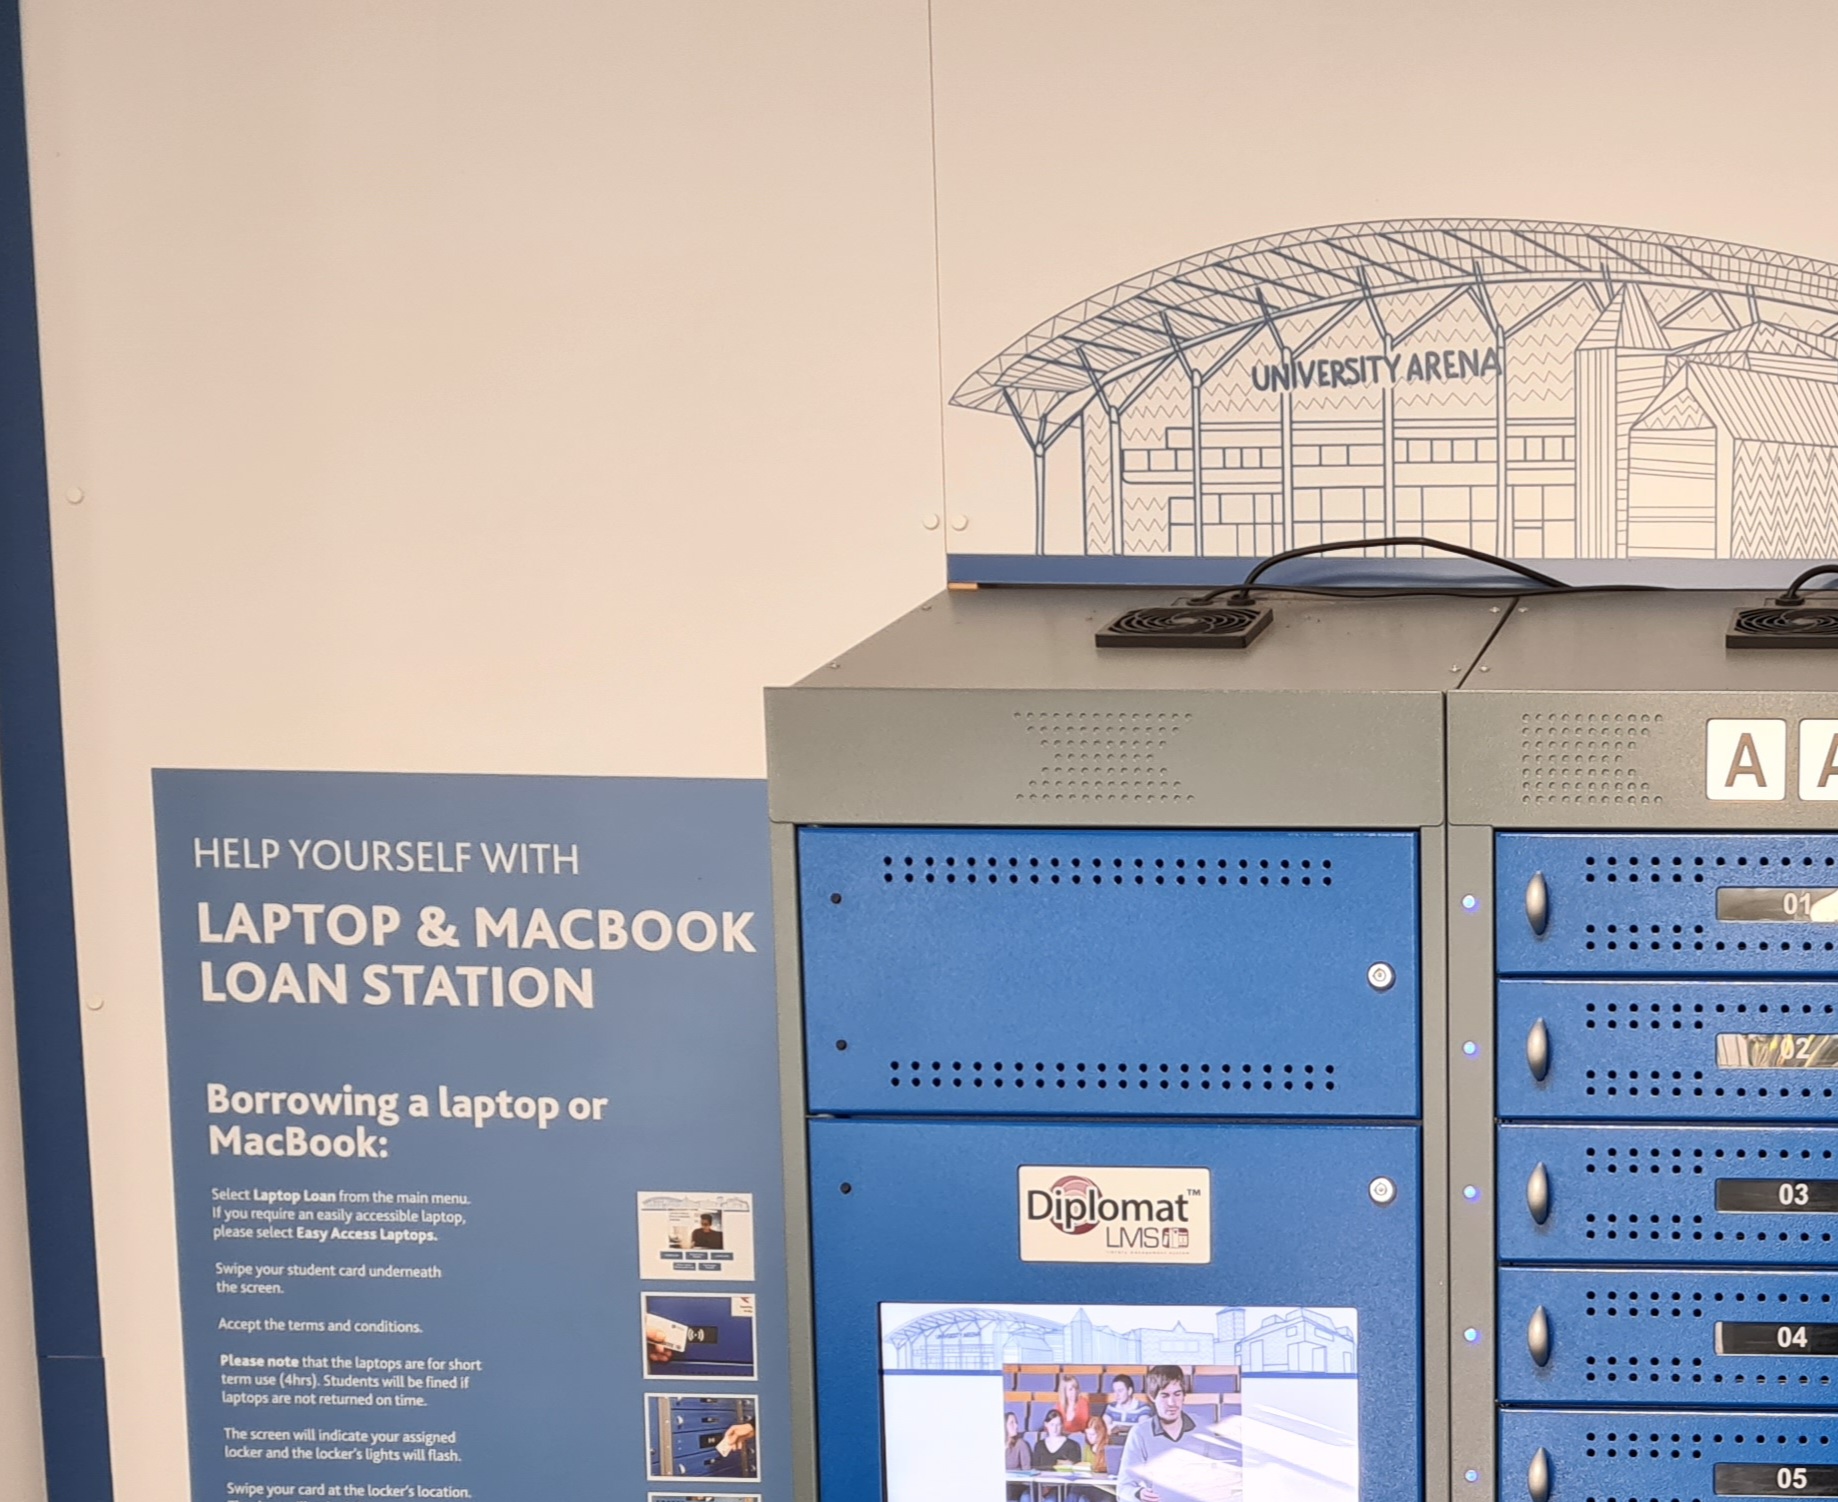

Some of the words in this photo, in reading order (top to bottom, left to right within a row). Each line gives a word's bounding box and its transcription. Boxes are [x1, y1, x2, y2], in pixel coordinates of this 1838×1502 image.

[1252, 354, 1401, 392] UNIVERSITY
[1407, 348, 1502, 381] ARENA
[1725, 733, 1767, 787] A
[195, 838, 279, 868] HELP
[289, 840, 471, 872] YOURSELF
[481, 843, 578, 874] WITH
[1783, 893, 1811, 915] 01
[199, 902, 400, 945] LAPTOP
[418, 906, 460, 947] &
[476, 907, 756, 952] MACBOOK
[202, 962, 347, 1004] LOAN
[364, 965, 593, 1008] STATION
[1780, 1038, 1809, 1060] 02
[208, 1084, 399, 1127] Borrowing
[409, 1095, 428, 1117] a
[439, 1086, 559, 1129] laptop
[569, 1098, 608, 1119] or
[210, 1125, 390, 1158] MacBook:
[212, 1188, 250, 1200] Select
[254, 1189, 302, 1204] Laptop
[304, 1190, 337, 1202] Loan
[337, 1190, 371, 1202] from
[373, 1191, 395, 1203] the
[397, 1192, 430, 1203] main
[432, 1195, 470, 1204] menu.
[1780, 1184, 1808, 1205] 03
[213, 1207, 223, 1218] If
[224, 1210, 249, 1222] you
[251, 1208, 295, 1222] require
[299, 1211, 313, 1220] an
[317, 1208, 354, 1224] easily
[356, 1209, 419, 1222] accessible
[422, 1210, 466, 1226] laptop,
[214, 1226, 253, 1240] please
[257, 1226, 293, 1238] select
[297, 1227, 328, 1242] Easy
[329, 1228, 378, 1240] Access
[380, 1228, 437, 1244] Laptops.
[1106, 1227, 1159, 1248] LMS
[216, 1263, 254, 1277] Swipe
[256, 1266, 286, 1278] your
[287, 1264, 336, 1276] student
[337, 1265, 367, 1277] card
[369, 1265, 441, 1278] underneath
[217, 1281, 237, 1293] the
[241, 1284, 284, 1293] screen.
[219, 1318, 263, 1333] Accept
[264, 1319, 287, 1330] the
[288, 1320, 326, 1331] terms
[326, 1320, 351, 1331] and
[352, 1320, 422, 1333] conditions.
[1778, 1327, 1807, 1347] 04
[1778, 1468, 1806, 1488] 05
